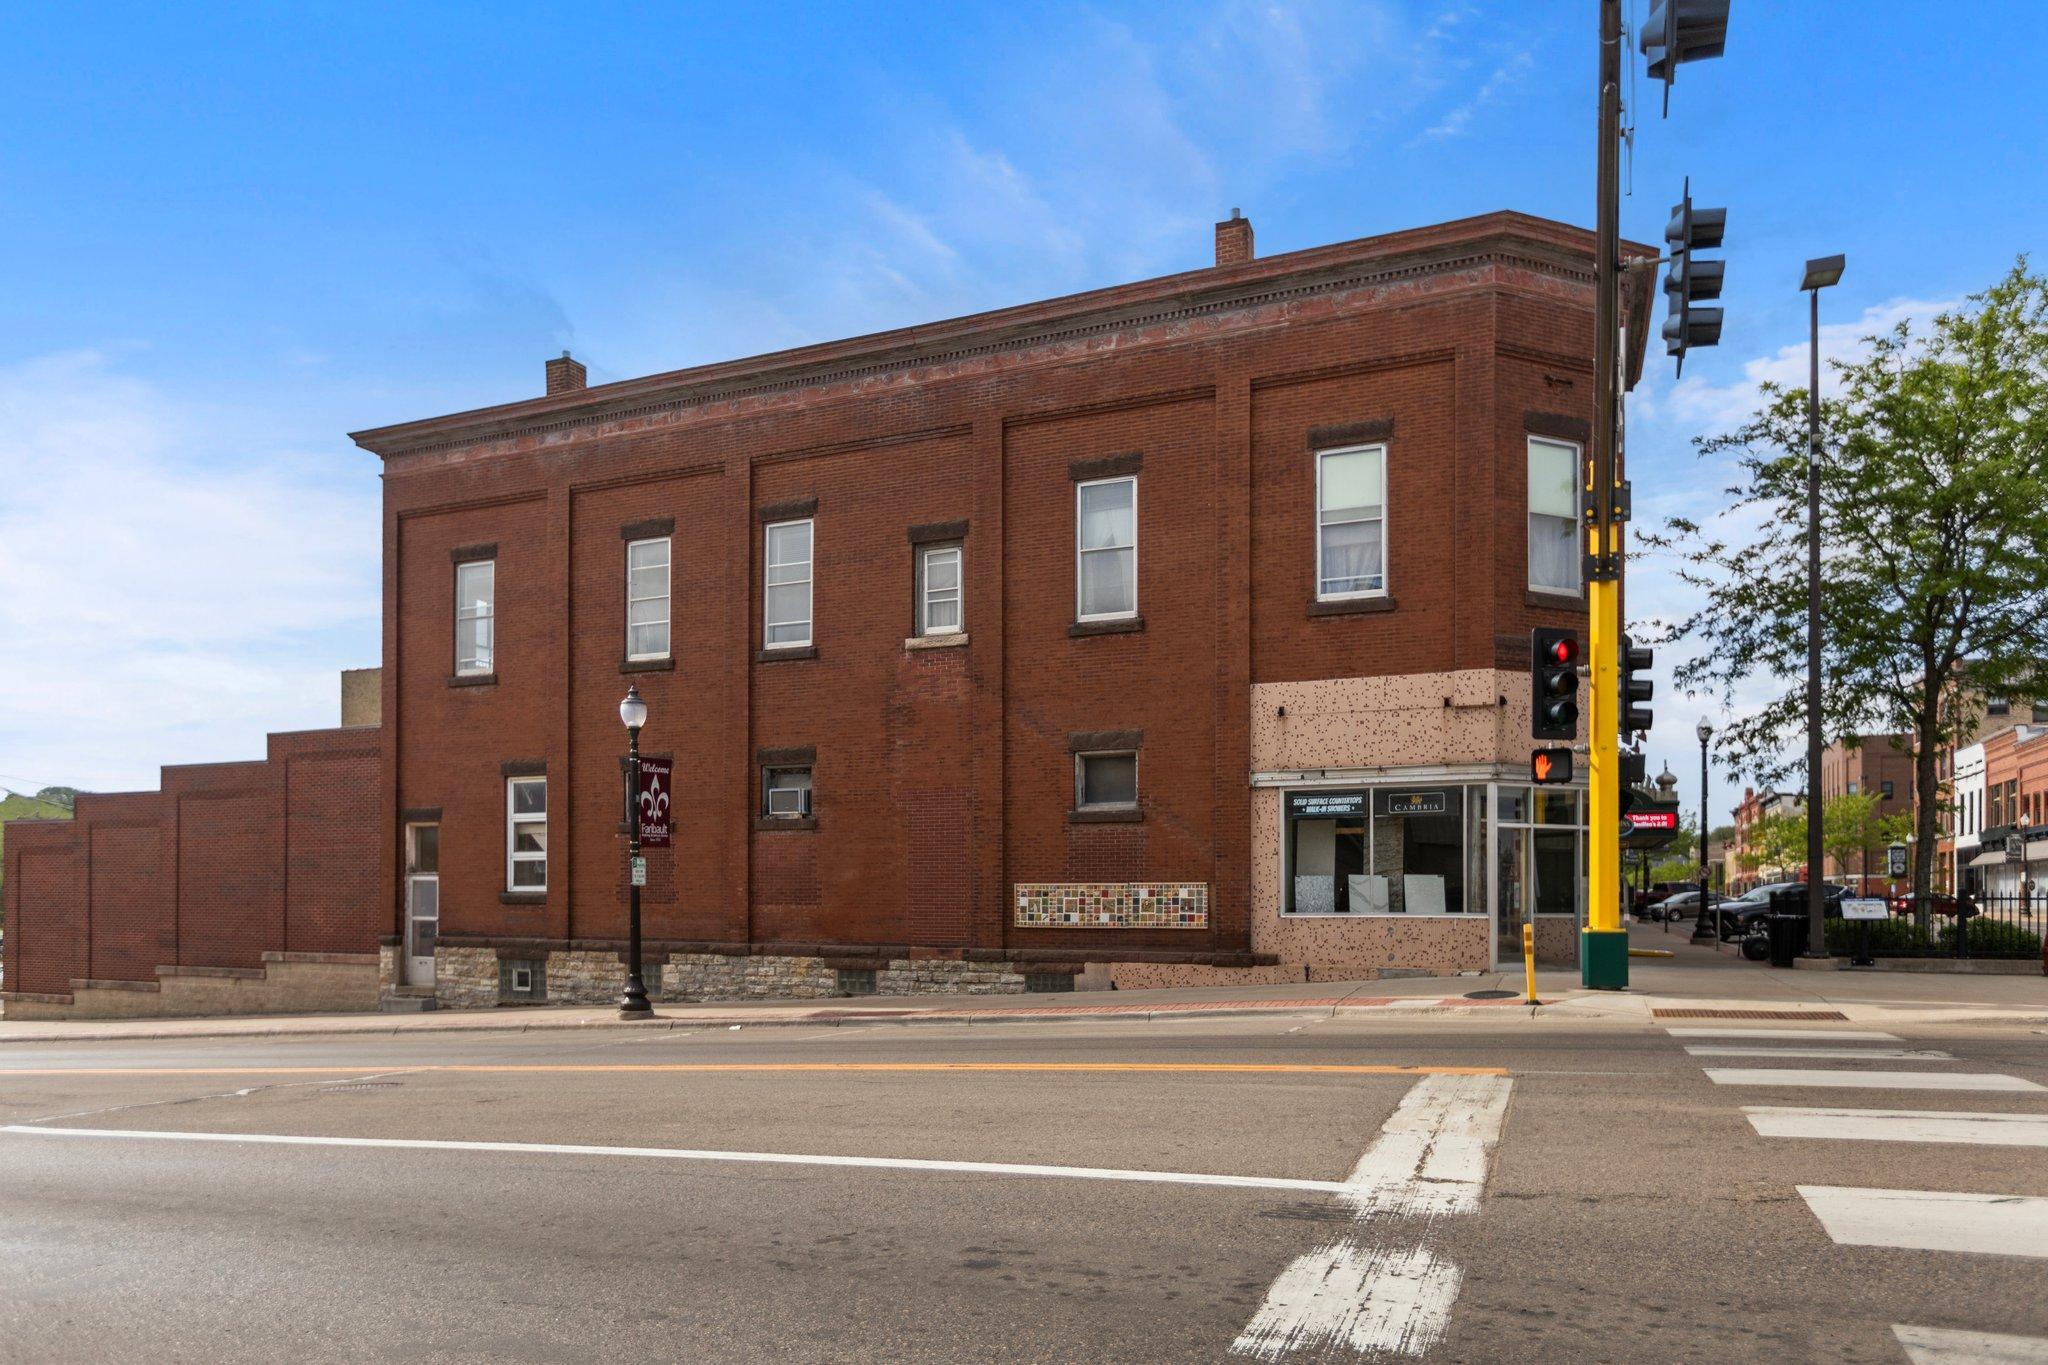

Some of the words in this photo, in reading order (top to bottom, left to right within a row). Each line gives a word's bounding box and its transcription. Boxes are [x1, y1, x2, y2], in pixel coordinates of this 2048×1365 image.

[642, 763, 669, 774] Welcome
[1293, 798, 1308, 806] SOLID
[1308, 797, 1329, 805] SURFACE
[1329, 796, 1363, 804] COUNTERTOPS
[1306, 805, 1327, 813] WALK-IN
[1327, 804, 1351, 812] SHOWERS
[1394, 803, 1440, 811] CAMBRIA
[641, 823, 668, 834] Faribault
